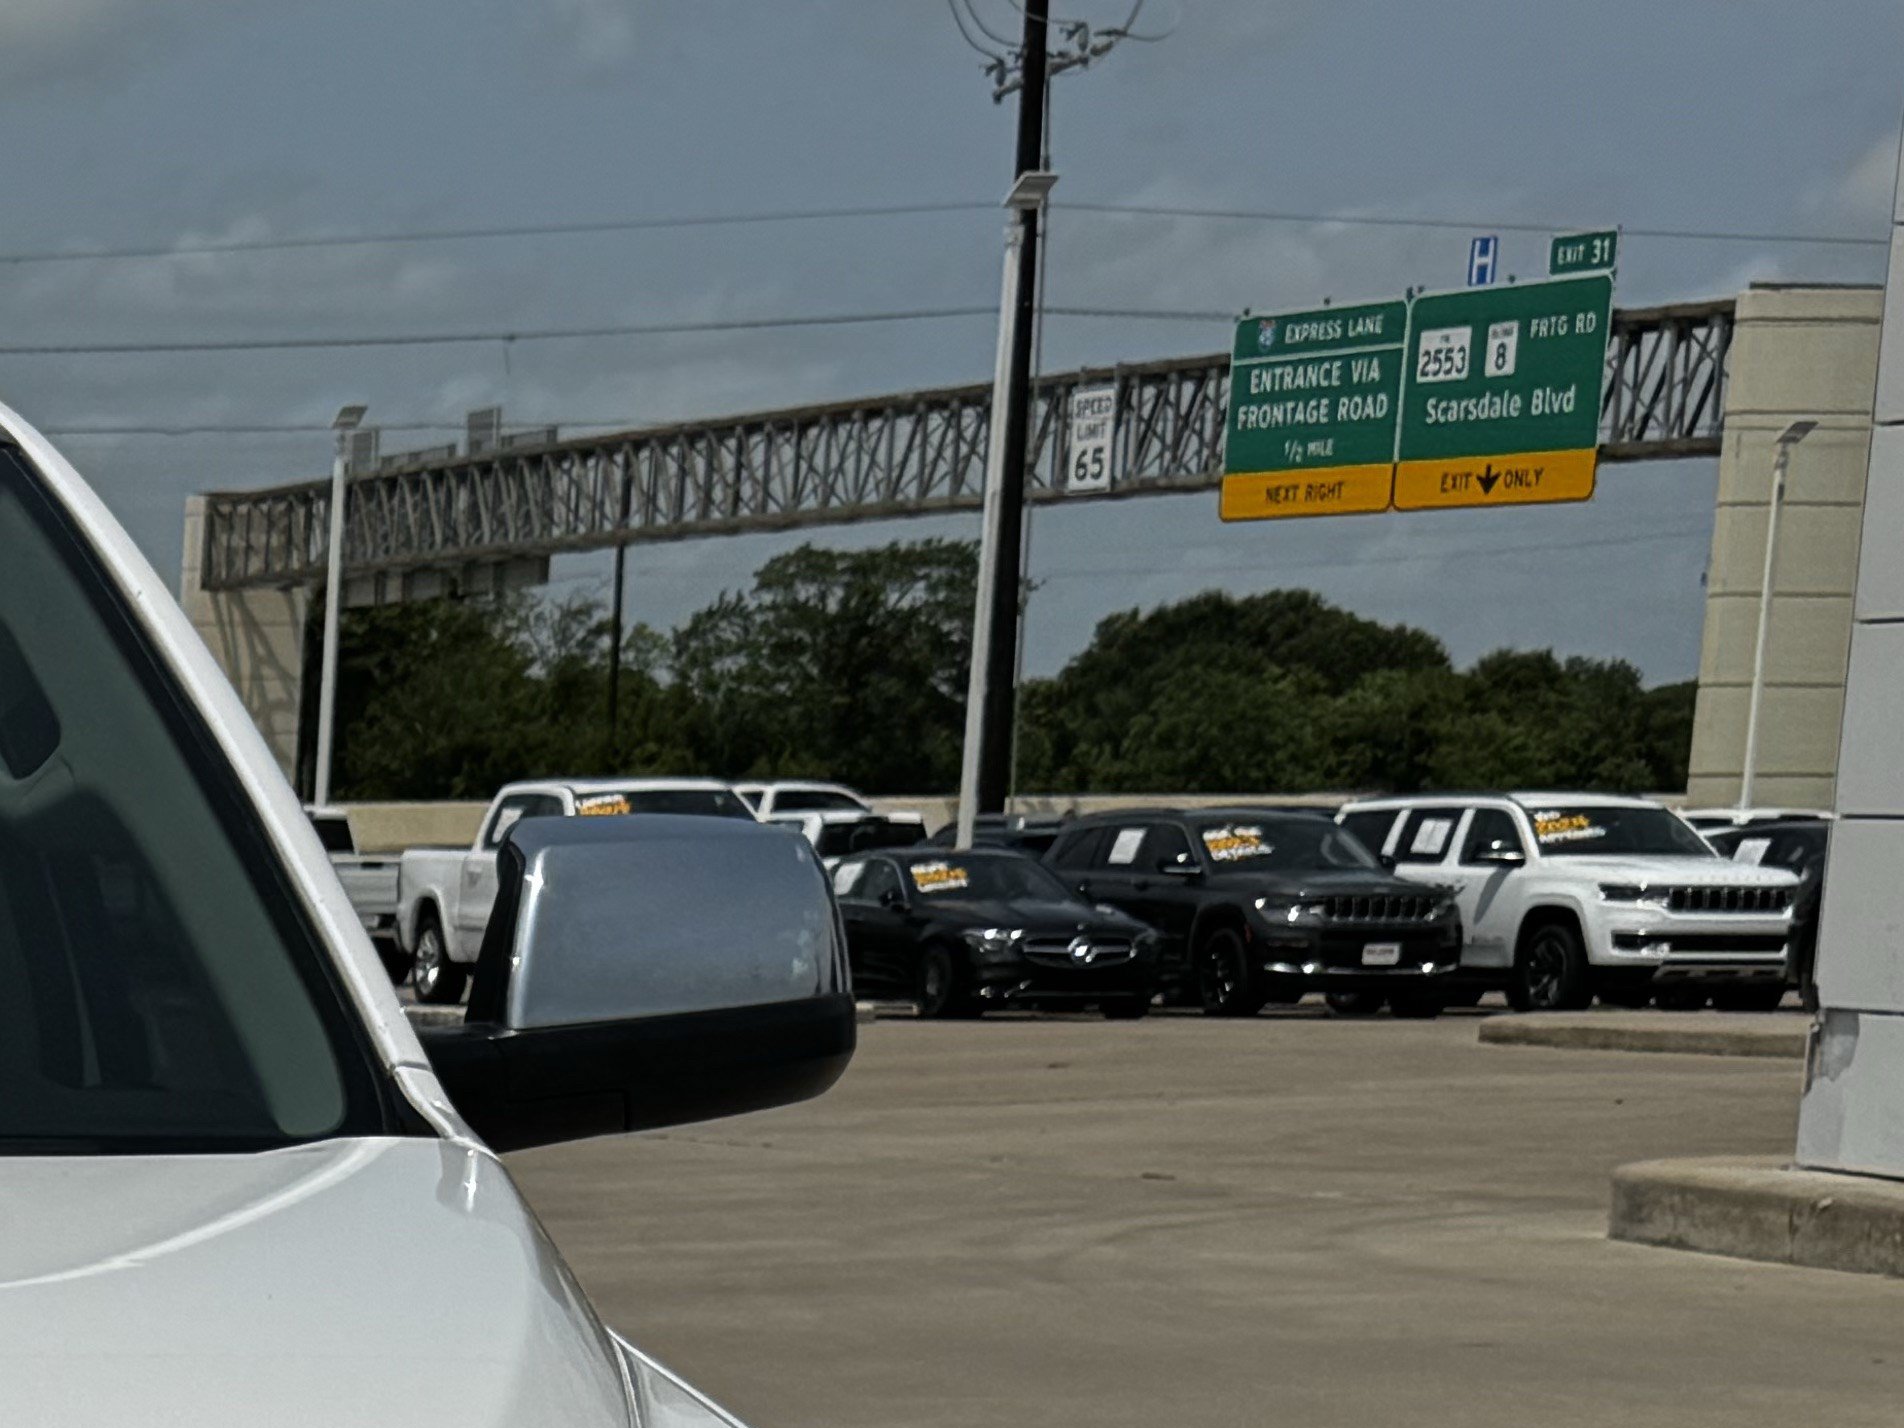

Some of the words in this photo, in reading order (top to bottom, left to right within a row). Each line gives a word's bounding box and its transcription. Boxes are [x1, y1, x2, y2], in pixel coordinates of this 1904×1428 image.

[1556, 243, 1585, 264] EXIT
[1591, 238, 1610, 264] 31
[1284, 319, 1342, 344] EXPRESS
[1348, 314, 1385, 337] LANE
[1529, 318, 1569, 339] FRTG
[1575, 311, 1597, 334] RD
[1420, 345, 1467, 377] 2553
[1495, 342, 1507, 370] 8
[1250, 360, 1342, 394] ENTRANCE
[1351, 357, 1381, 383] VIA
[1076, 397, 1112, 418] SPEED
[1237, 398, 1330, 430] FRONTAGE
[1337, 392, 1389, 422] ROAD
[1425, 388, 1522, 424] Scarsdale
[1530, 383, 1576, 416] Blvd
[1077, 423, 1106, 442] LIMIT
[1074, 446, 1105, 482] 65
[1265, 484, 1299, 504] NEXT
[1305, 481, 1345, 502] RIGHT
[1440, 472, 1472, 493] EXIT
[1504, 467, 1544, 489] ONLY
